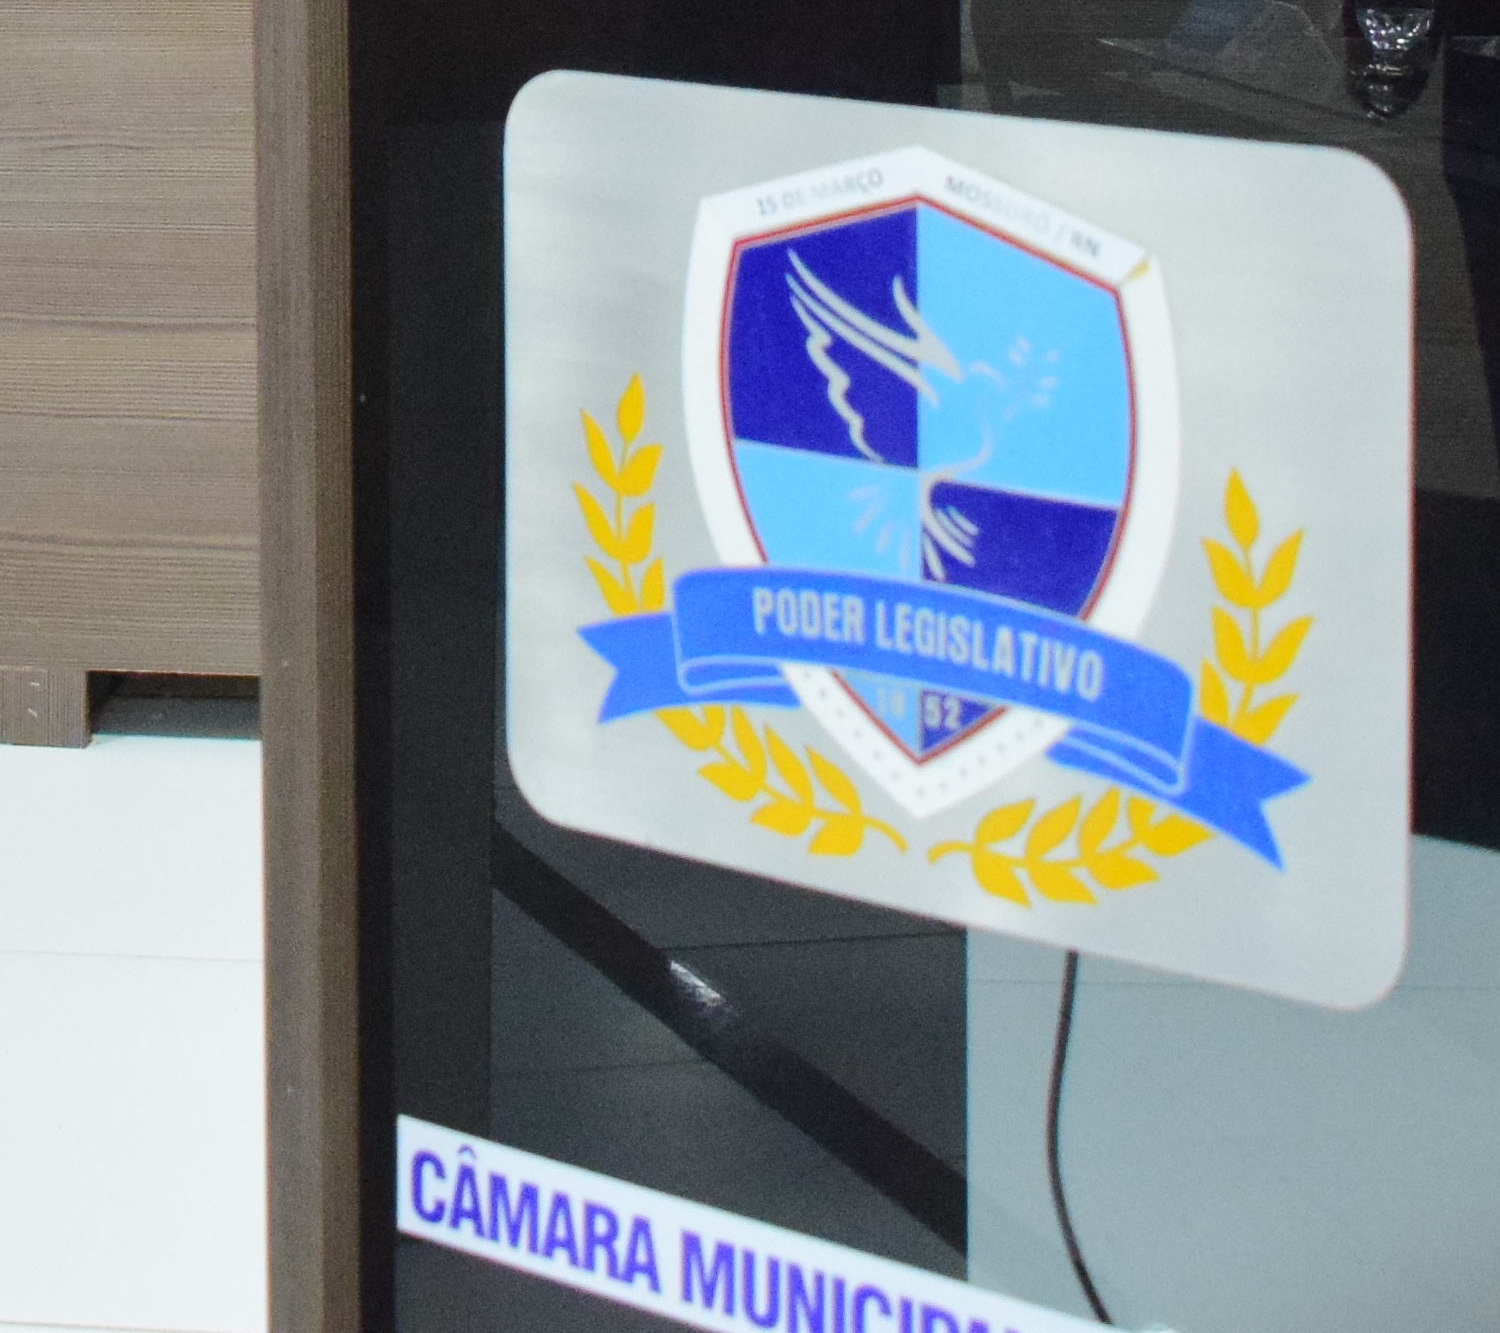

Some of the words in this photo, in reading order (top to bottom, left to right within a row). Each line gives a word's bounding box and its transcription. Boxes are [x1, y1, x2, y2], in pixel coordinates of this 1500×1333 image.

[752, 586, 866, 646] PODER
[874, 599, 1104, 702] LEGISLATIVO
[409, 1145, 662, 1293] CÂMARA
[680, 1229, 1027, 1333] MUNIC
